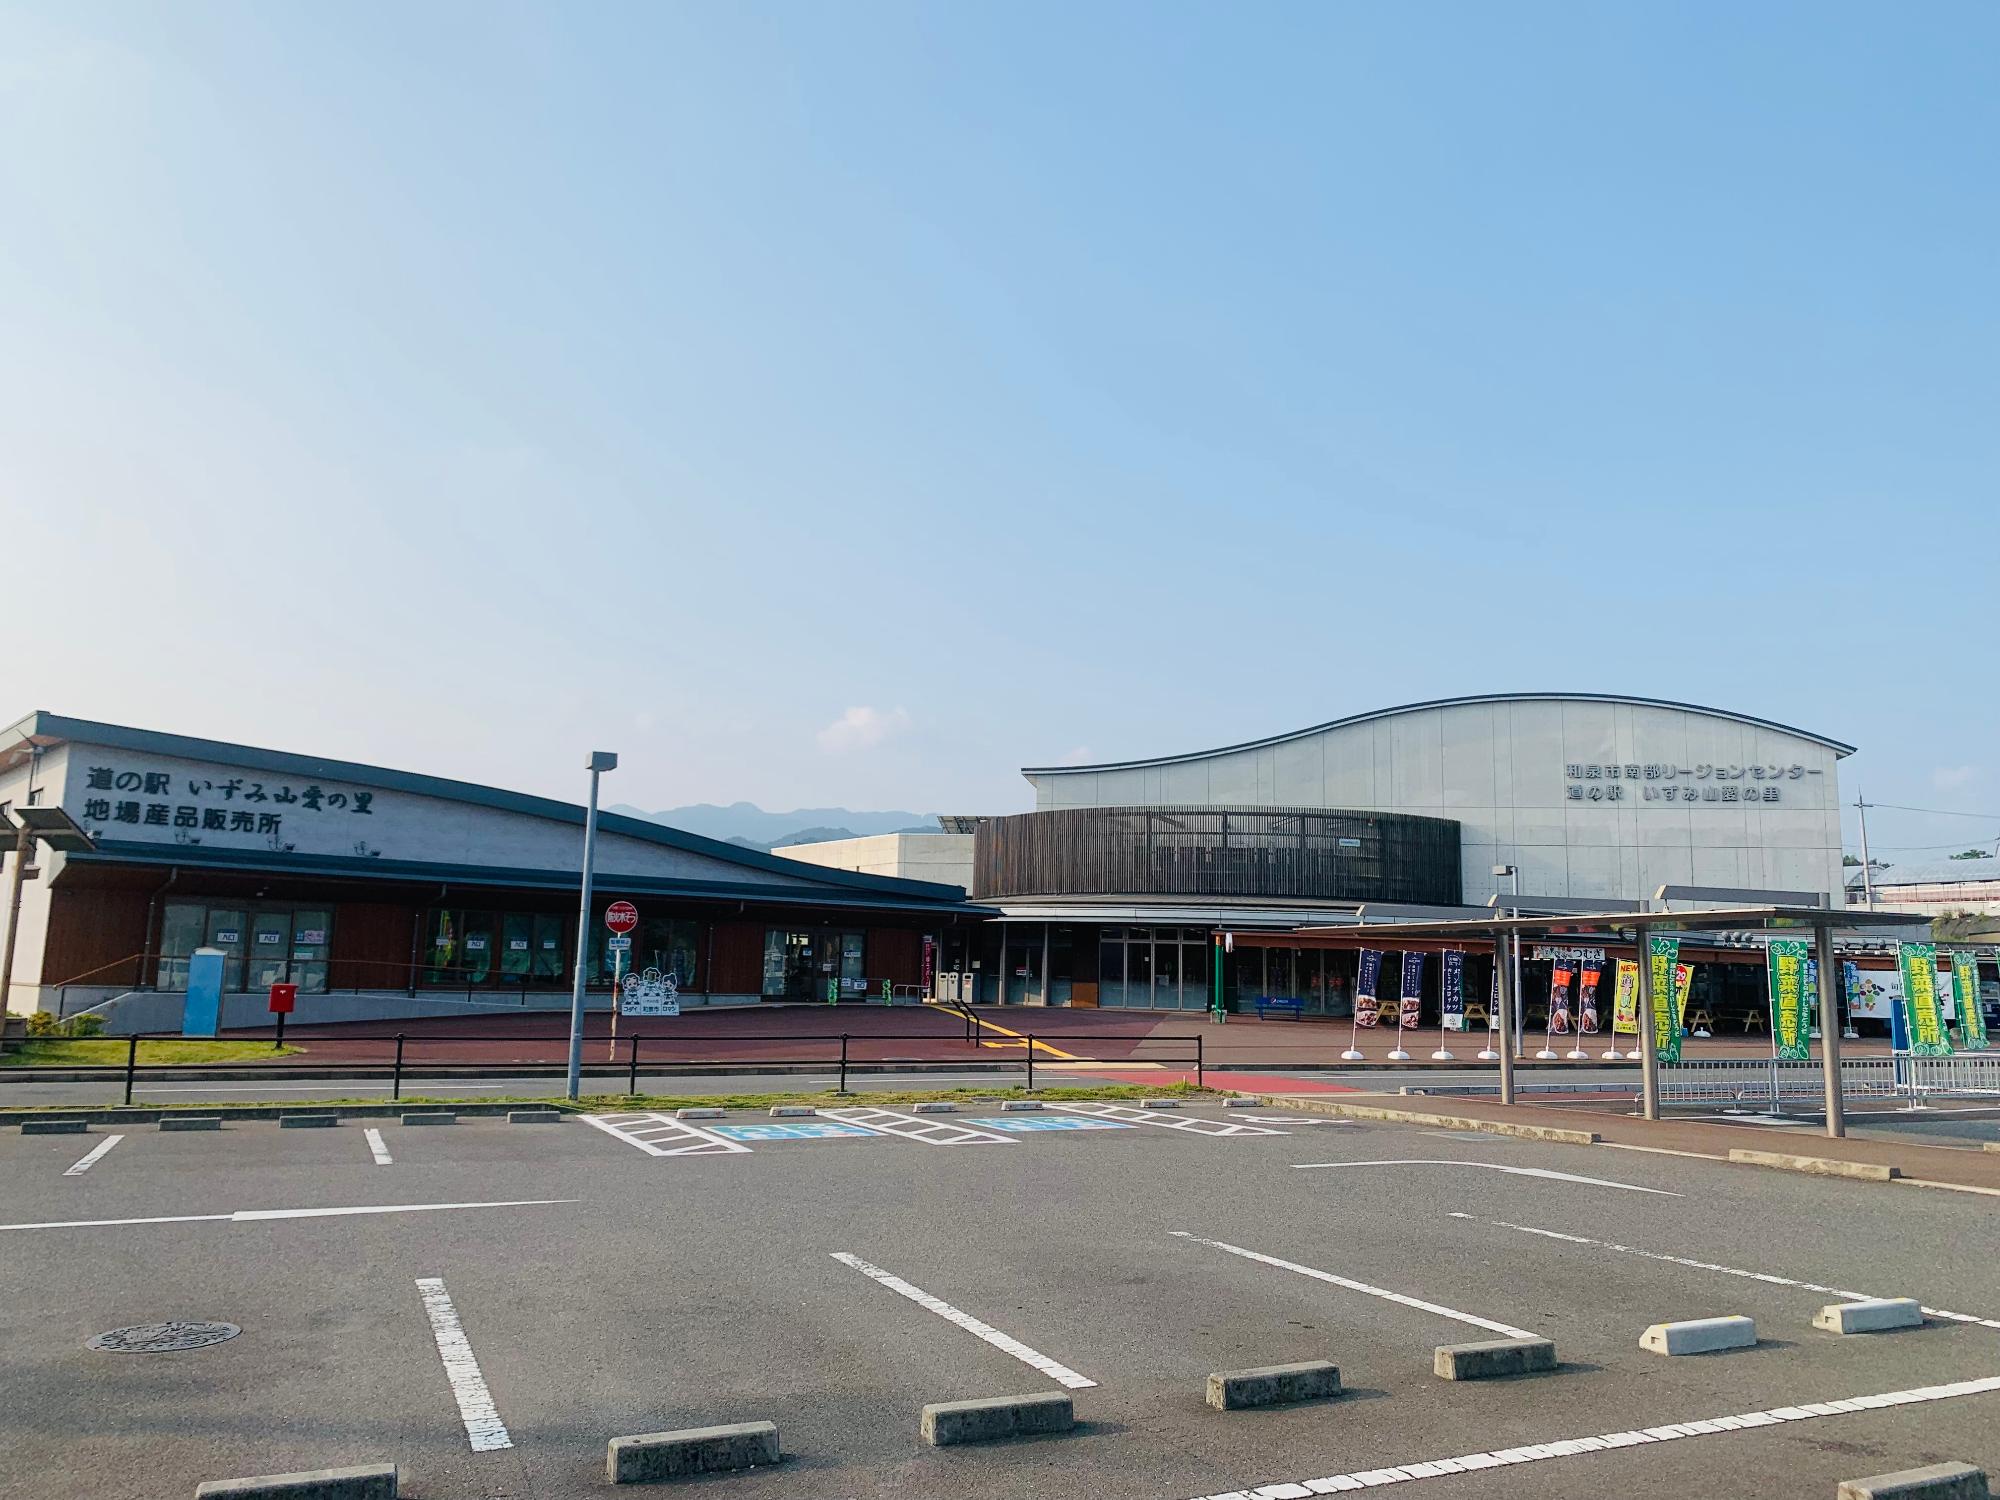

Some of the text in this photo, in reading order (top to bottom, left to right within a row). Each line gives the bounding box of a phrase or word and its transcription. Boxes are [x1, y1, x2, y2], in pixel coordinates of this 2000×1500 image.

[86, 766, 374, 815] 道の駅 いずみ山愛の里
[1567, 764, 1823, 780] 和泉市南部リージョンセンター
[1567, 785, 1781, 801] 道の駅 いずみ山愛の里
[82, 798, 282, 835] 地場産品販売所
[1620, 964, 1639, 973] NEW
[1651, 955, 1670, 1050] 野菜直売所
[1777, 955, 1798, 1047] 野菜直売所
[1909, 957, 1940, 1045] 野菜直売所
